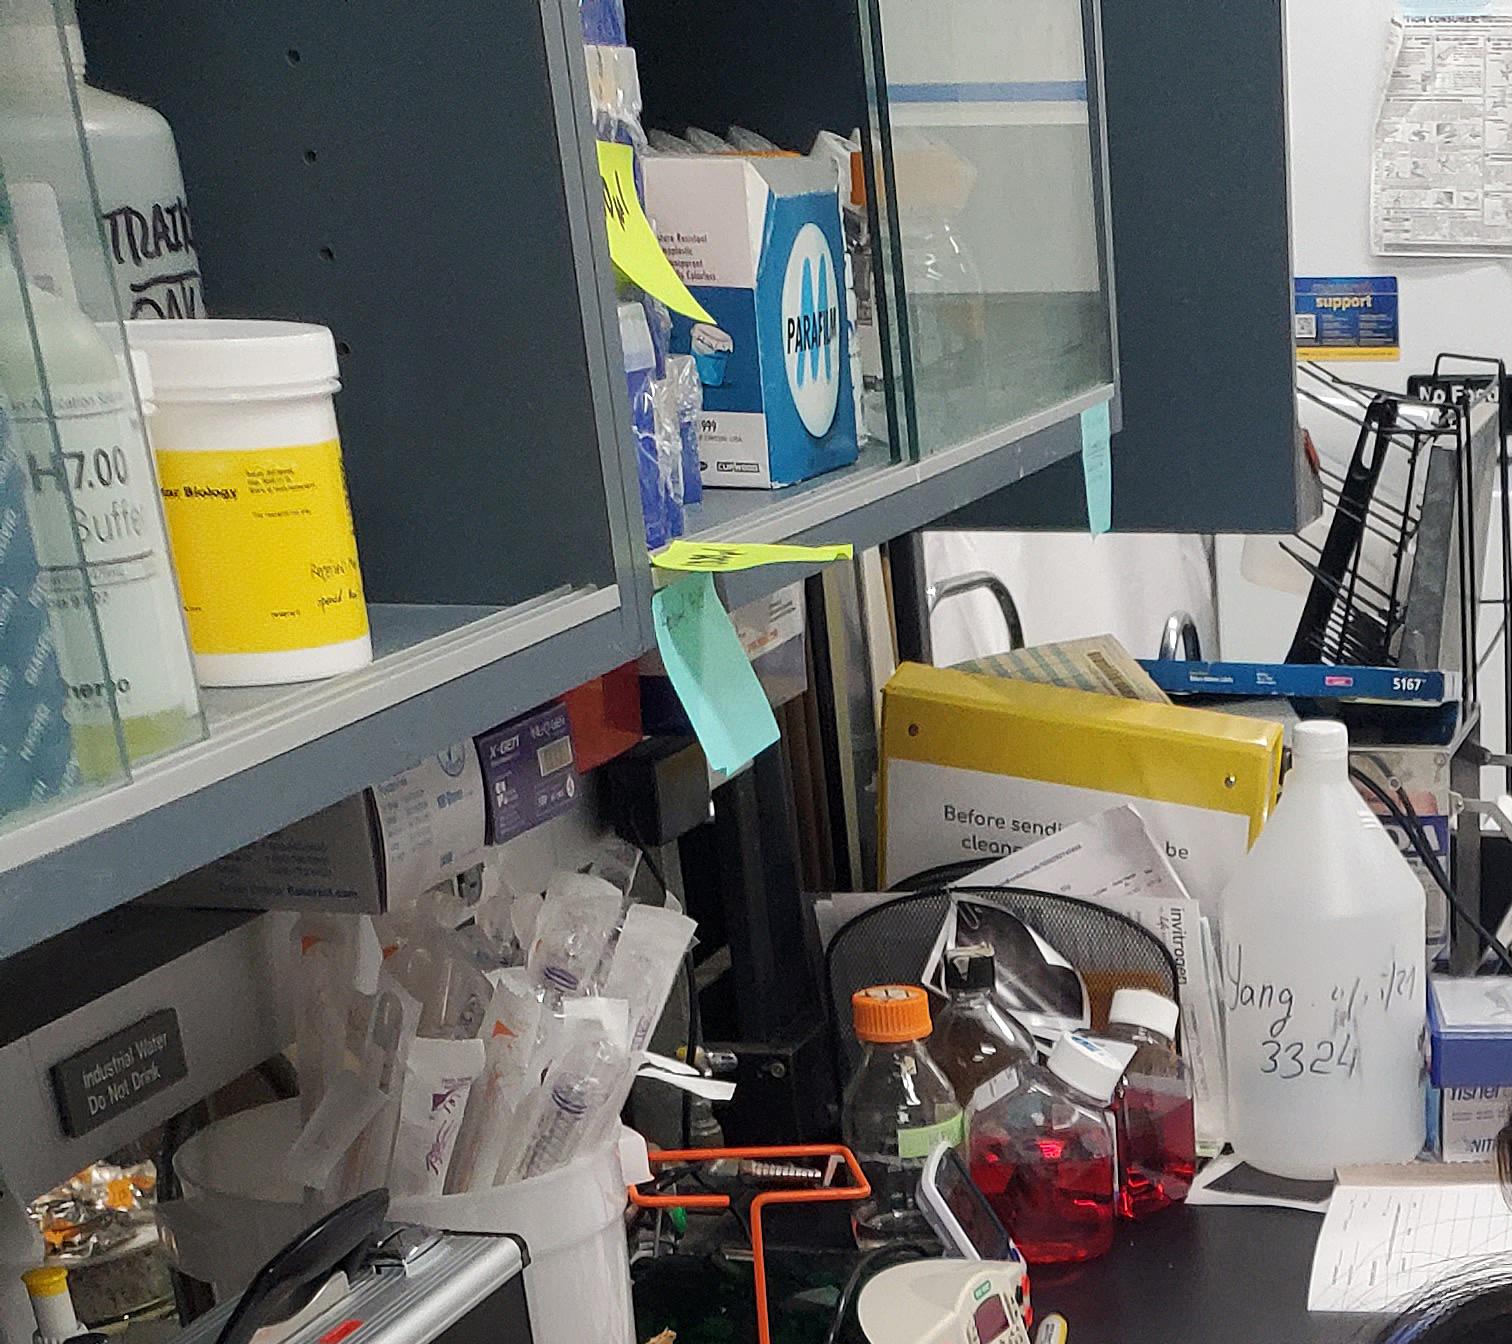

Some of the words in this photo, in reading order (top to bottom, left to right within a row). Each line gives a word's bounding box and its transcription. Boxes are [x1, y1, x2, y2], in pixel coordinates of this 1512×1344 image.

[1315, 294, 1372, 311] support
[786, 308, 837, 355] PARAFILM
[1419, 385, 1446, 403] No
[1393, 676, 1421, 692] 5167
[944, 804, 1006, 830] Before
[1164, 840, 1190, 860] be
[1225, 943, 1294, 1039] Yang
[82, 1046, 135, 1090] Industrial
[135, 1032, 168, 1061] Water
[1260, 1034, 1358, 1080] 3324
[87, 1094, 107, 1116] Do
[107, 1077, 131, 1105] Not
[131, 1060, 162, 1091] Drink
